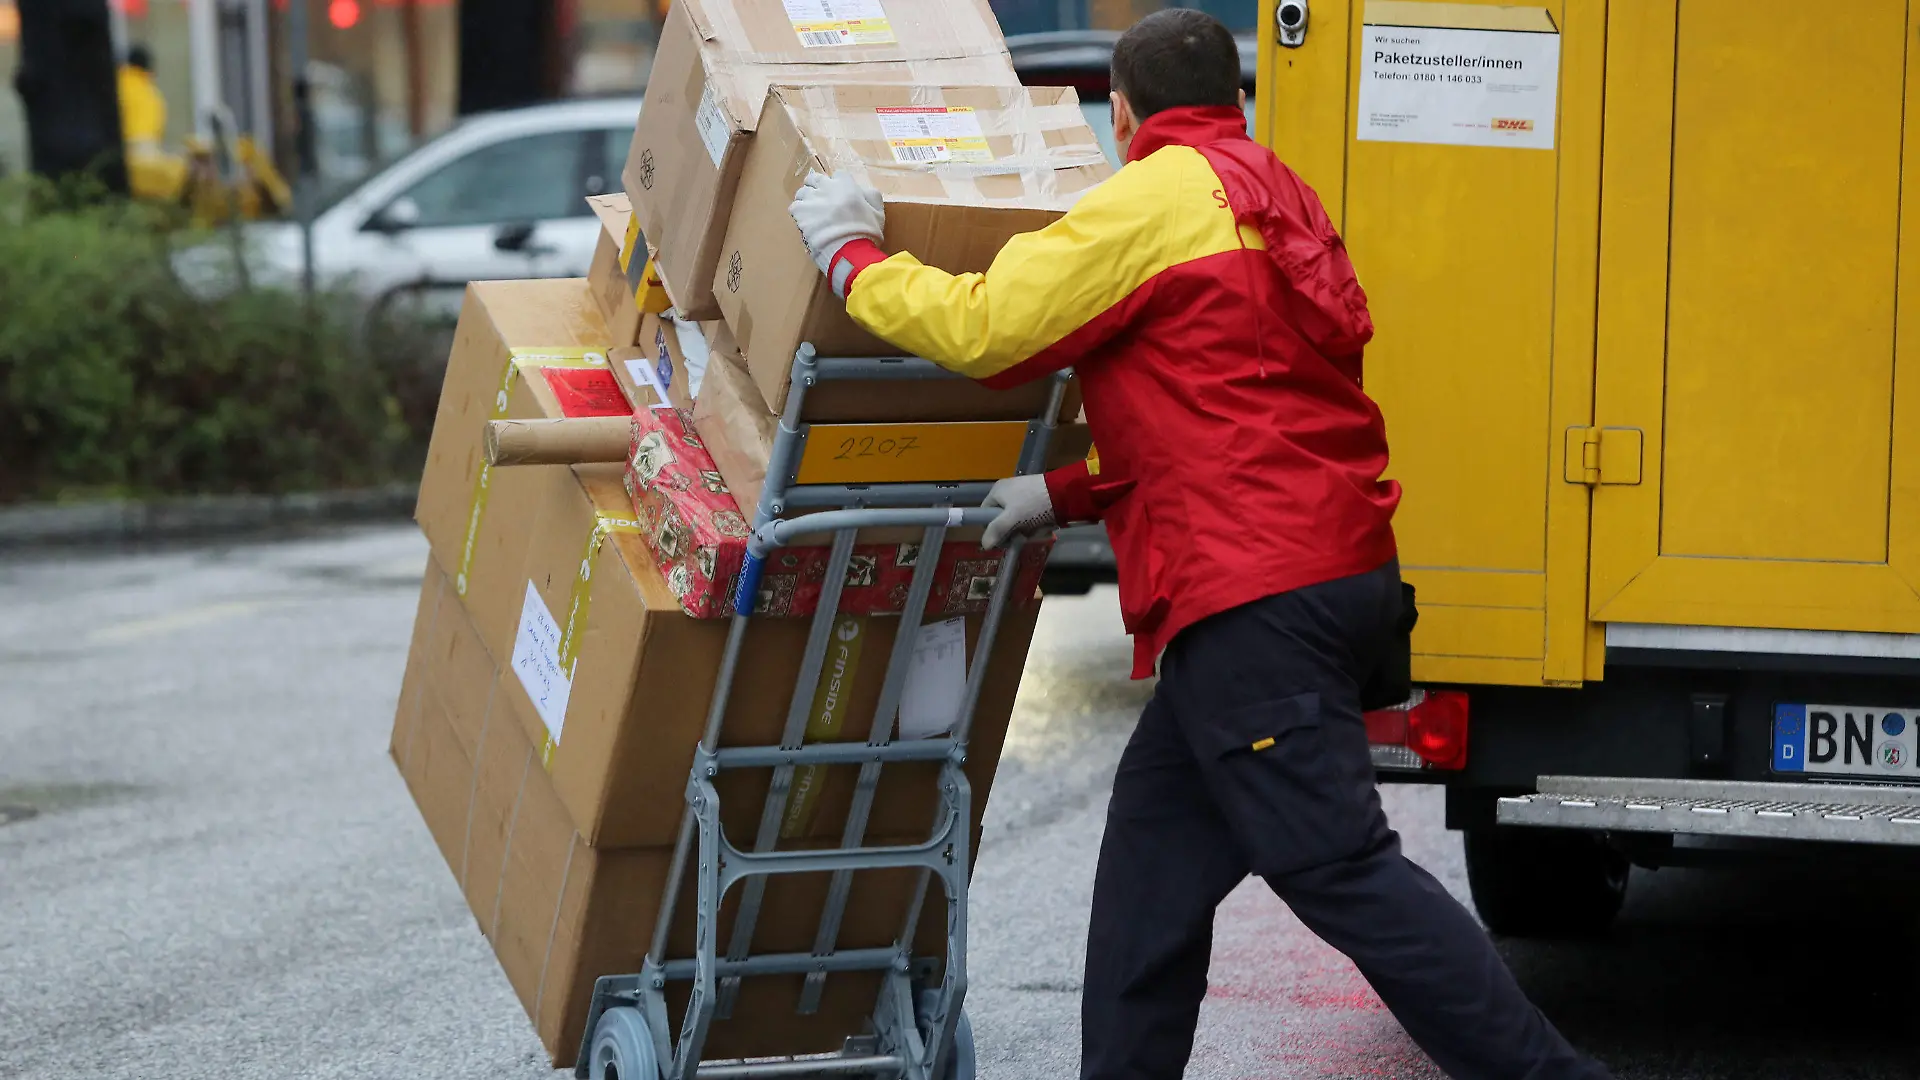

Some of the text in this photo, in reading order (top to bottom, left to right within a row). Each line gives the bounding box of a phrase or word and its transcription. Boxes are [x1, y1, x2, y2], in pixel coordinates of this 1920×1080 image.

[1375, 35, 1420, 45] Wir suchen
[1374, 51, 1523, 69] Paketzusteller/innen
[1373, 71, 1411, 81] Telefon:
[1413, 73, 1436, 82] 0180
[1447, 74, 1463, 83] 146
[1465, 75, 1482, 84] 033
[1497, 120, 1528, 130] DHL
[832, 436, 921, 460] 2207
[821, 645, 849, 725] FINSIDE
[1808, 711, 1874, 765] BN
[1782, 744, 1794, 759] D
